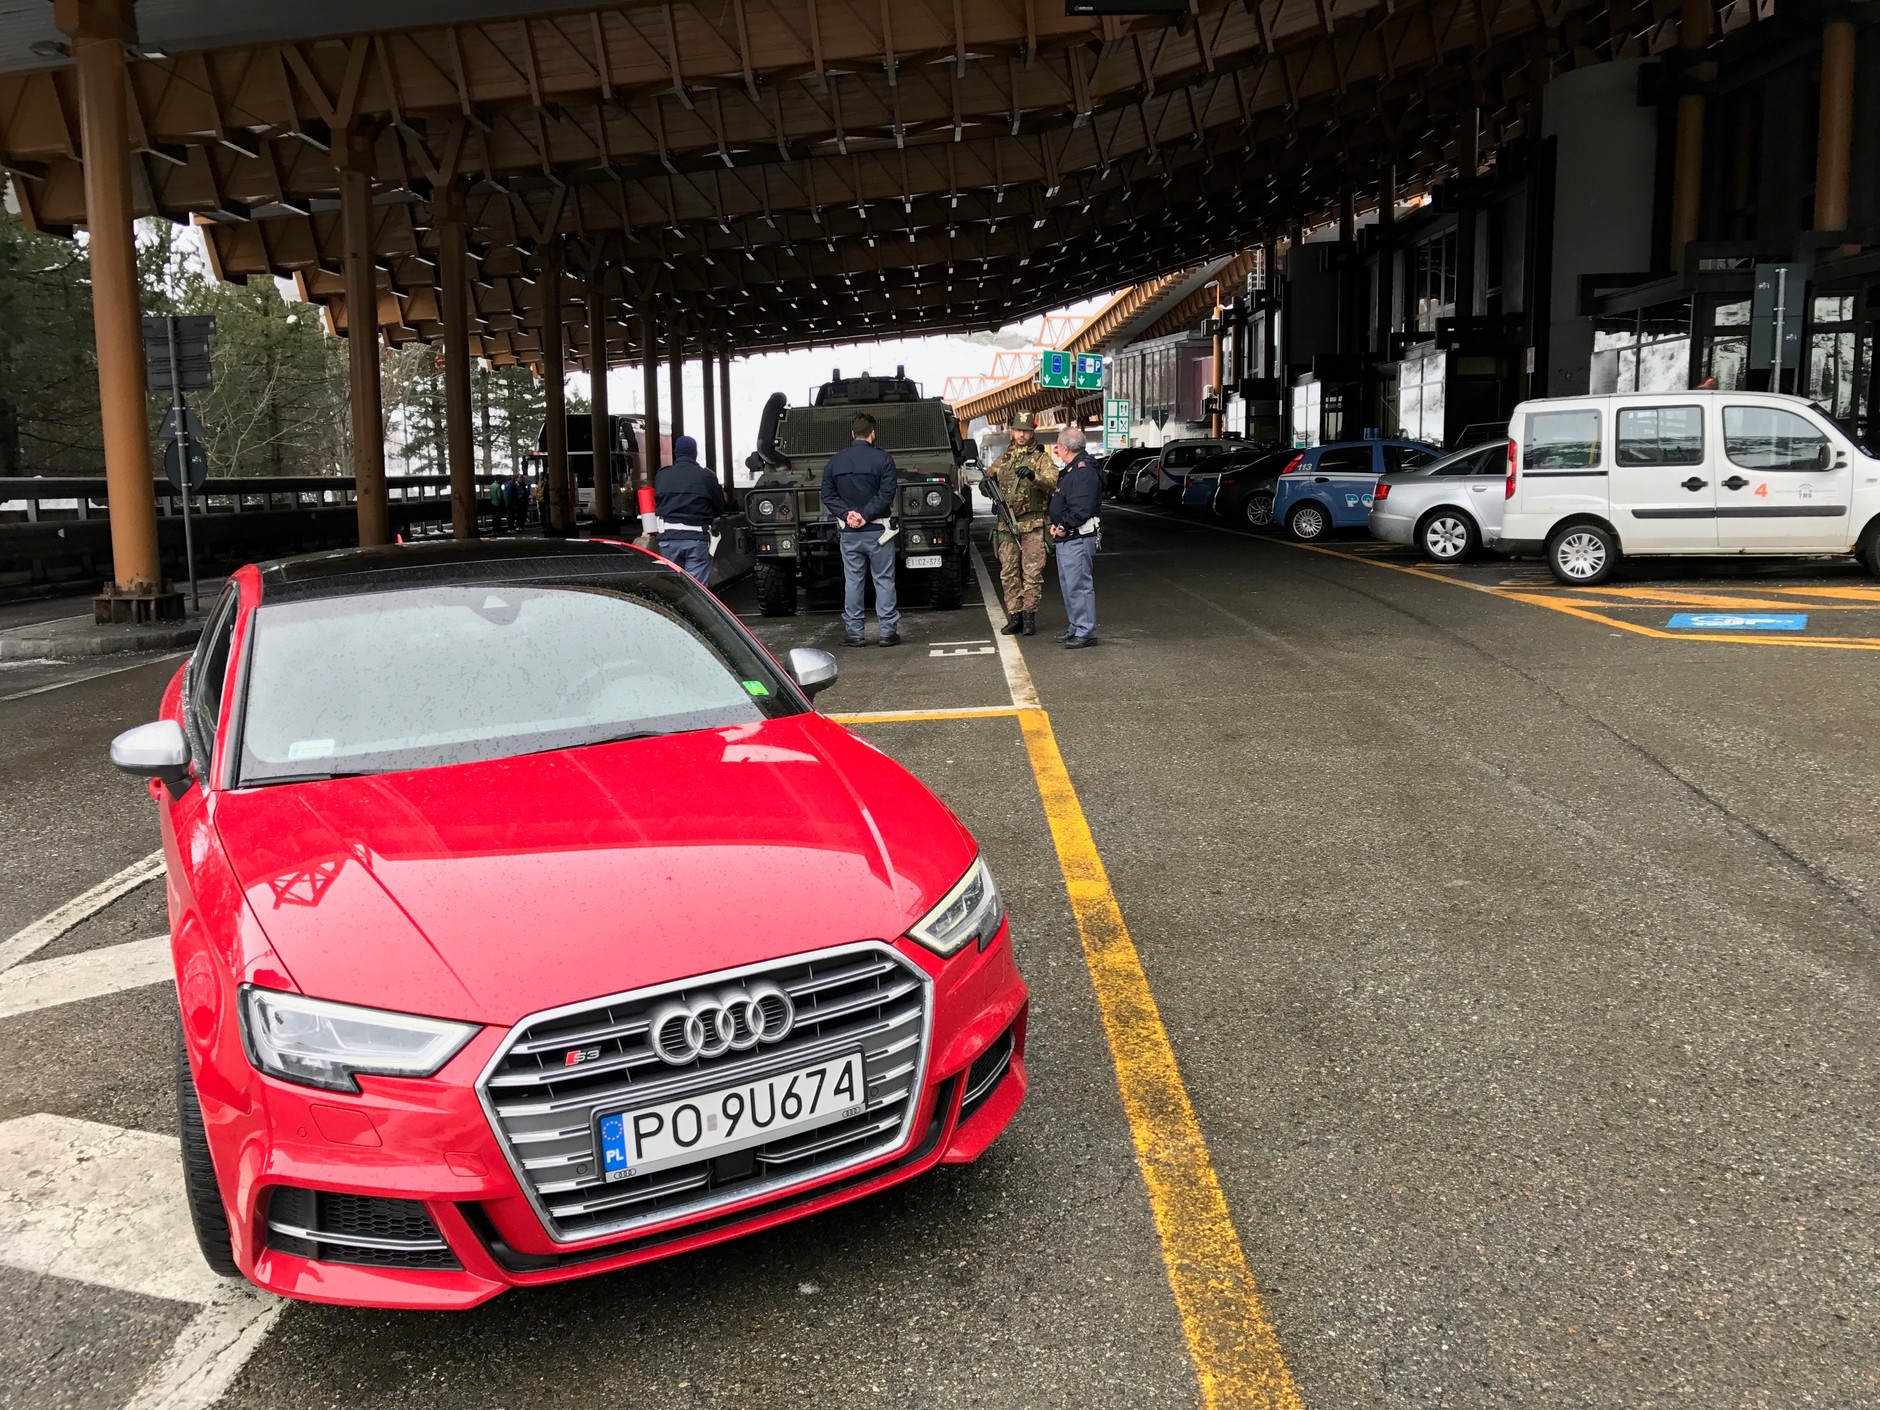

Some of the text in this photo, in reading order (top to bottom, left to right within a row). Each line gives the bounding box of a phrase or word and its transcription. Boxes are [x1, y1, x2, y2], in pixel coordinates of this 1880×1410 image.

[1754, 483, 1768, 497] 4
[573, 1049, 600, 1062] S3
[633, 1060, 855, 1159] PO 9U674
[606, 1149, 624, 1163] PL
